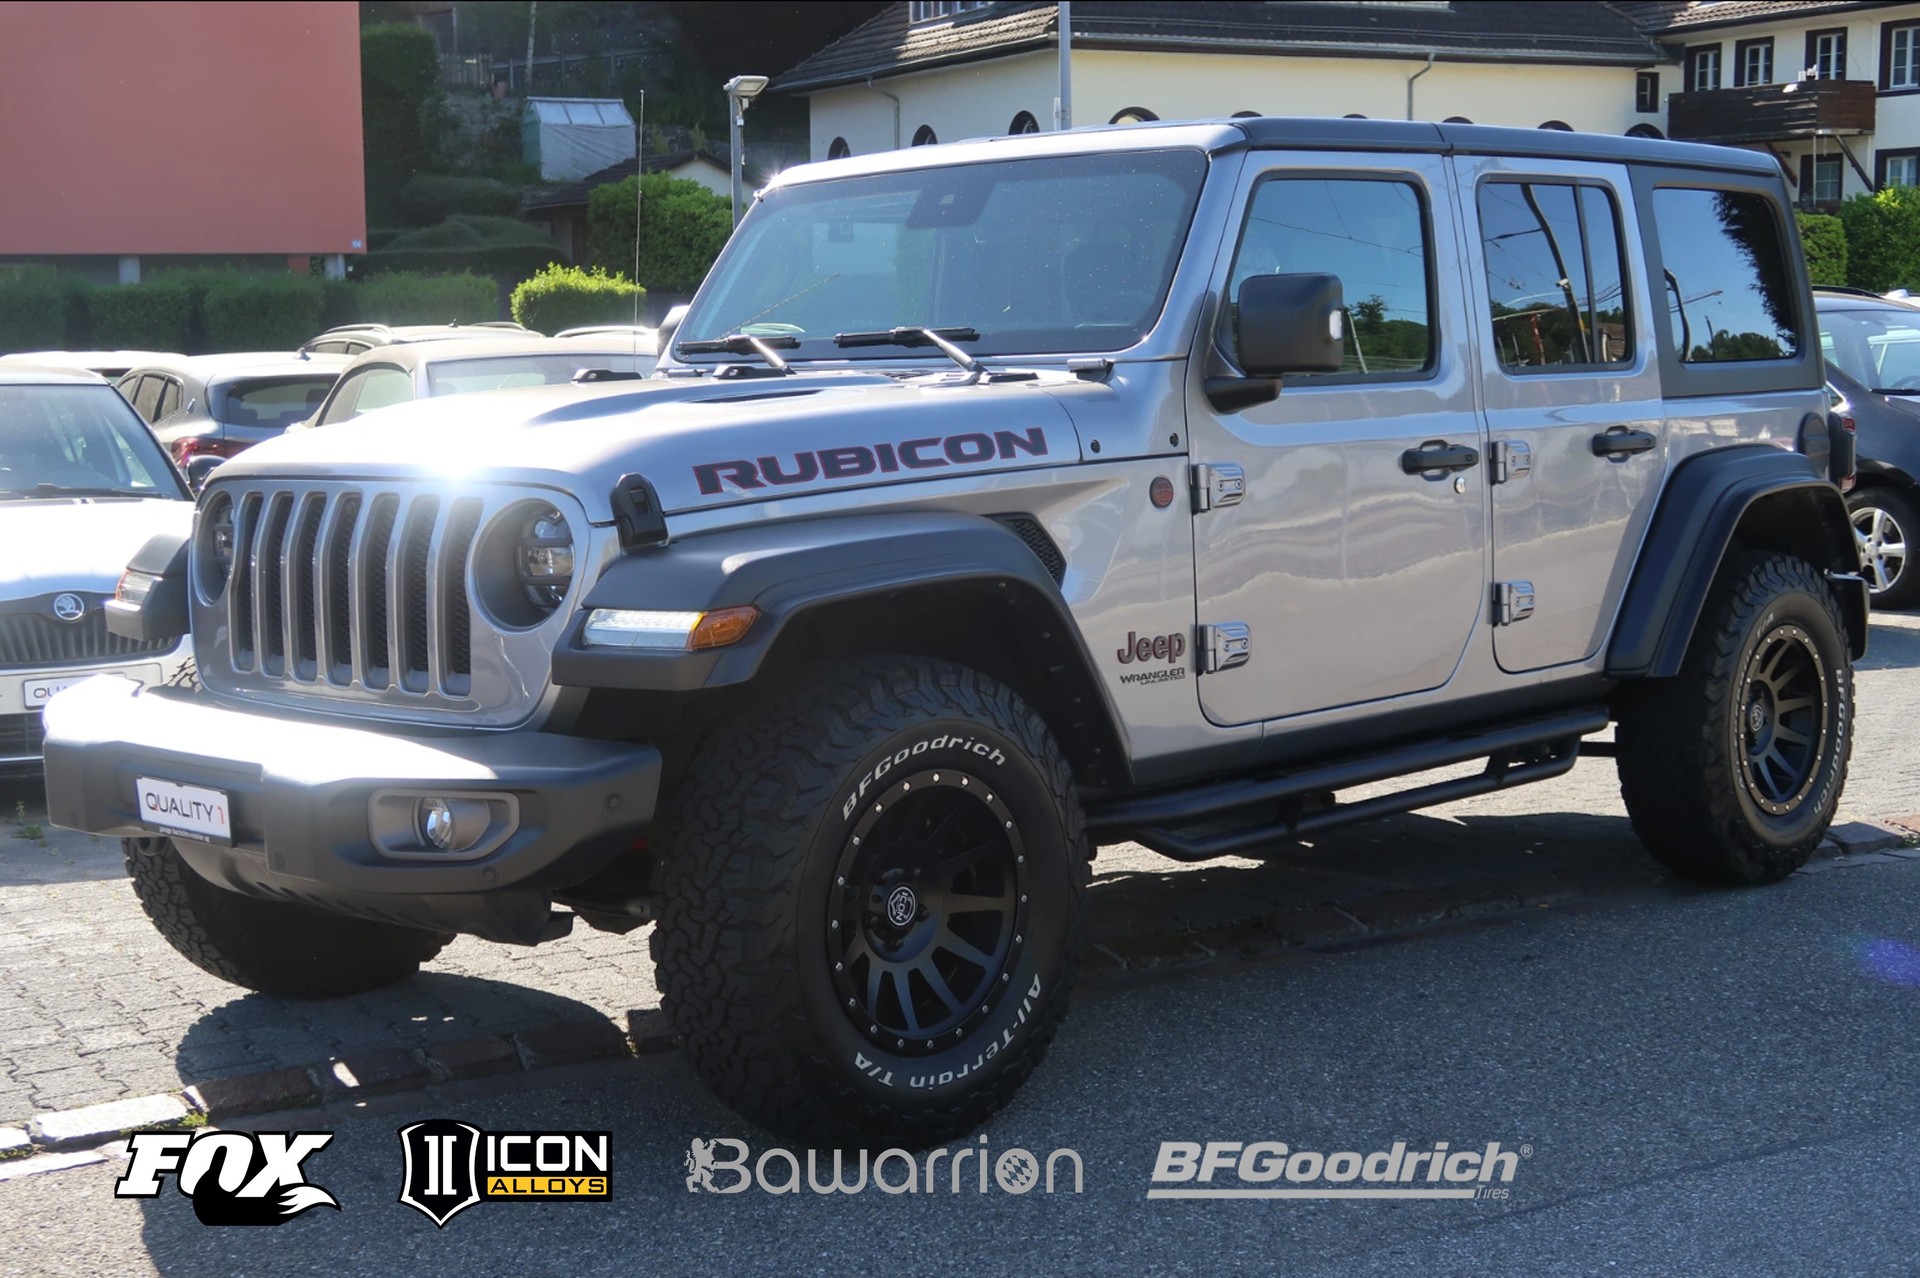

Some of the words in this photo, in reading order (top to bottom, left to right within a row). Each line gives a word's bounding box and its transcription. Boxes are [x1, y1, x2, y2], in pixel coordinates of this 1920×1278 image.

[692, 427, 1049, 495] RUBICON
[1117, 631, 1186, 665] Jeep
[1120, 667, 1185, 684] WRANGLER
[1140, 675, 1186, 686] UNLIMITED
[843, 734, 1007, 822] BFGoodrich
[909, 973, 1042, 1091] All-Terrain
[854, 1051, 894, 1087] T/A
